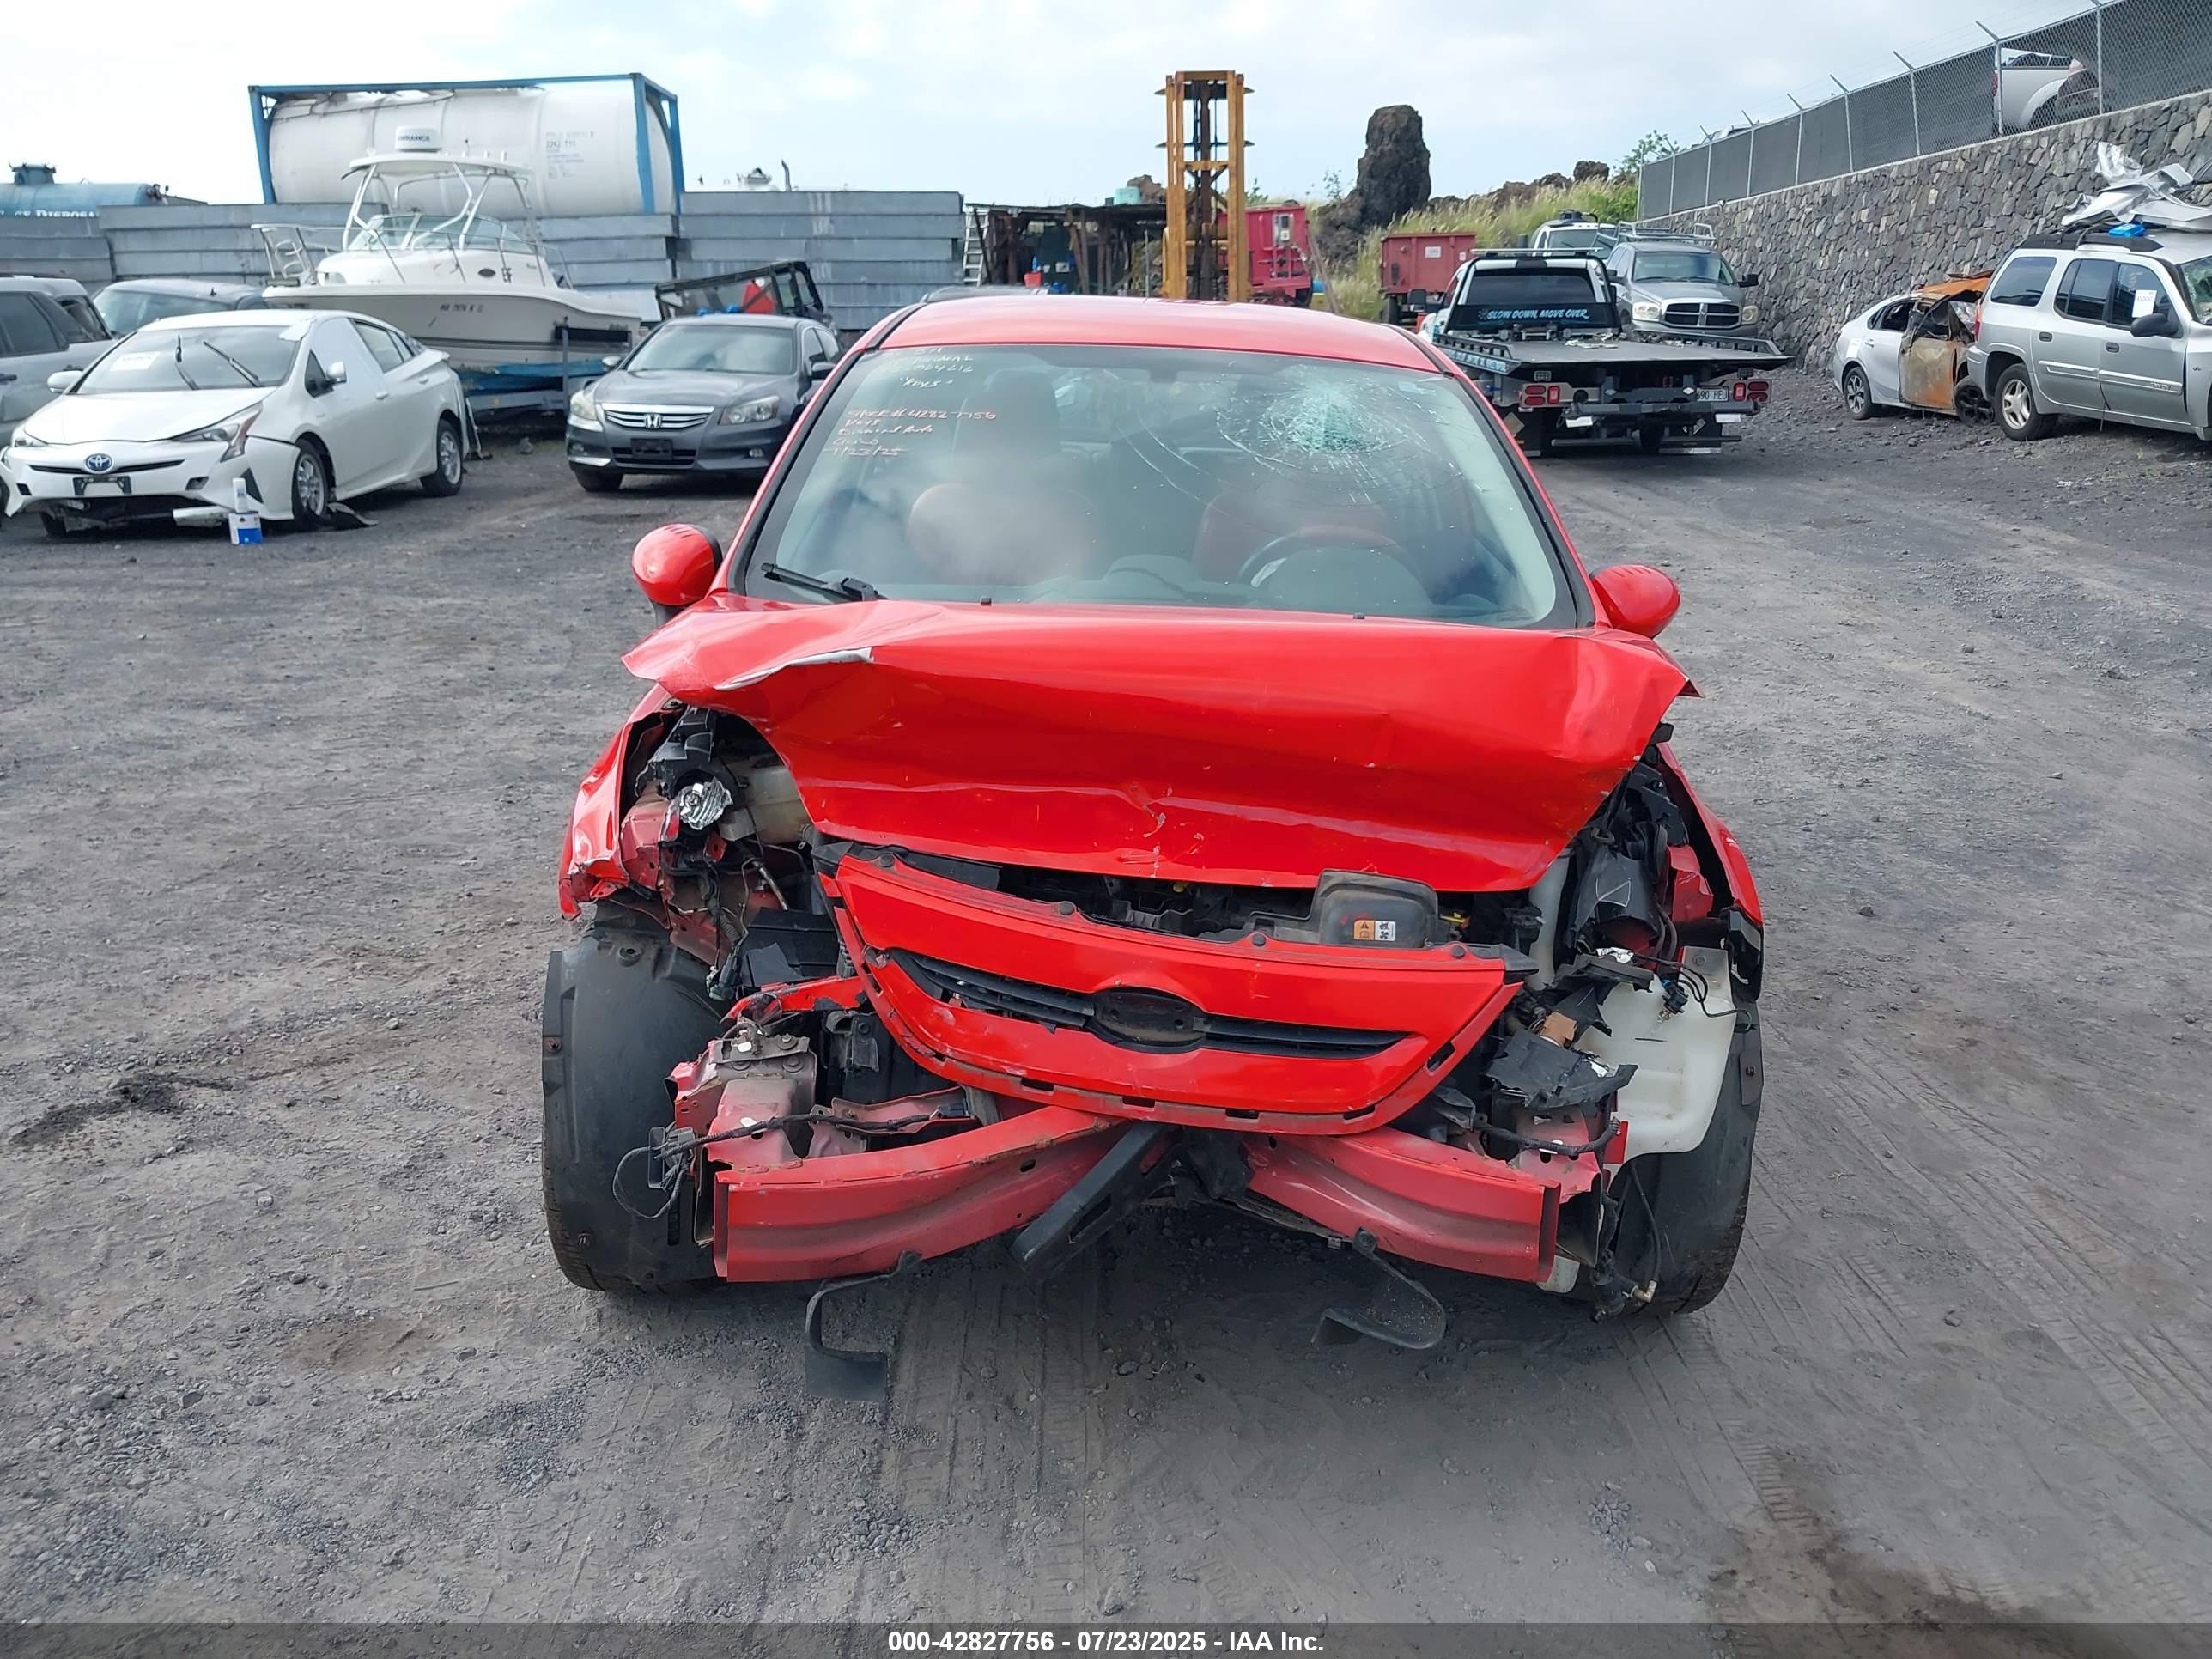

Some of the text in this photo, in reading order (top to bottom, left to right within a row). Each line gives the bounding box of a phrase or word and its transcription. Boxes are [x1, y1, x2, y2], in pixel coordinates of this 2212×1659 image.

[1486, 310, 1512, 319] SLOW
[1539, 309, 1564, 319] MOVE
[1565, 308, 1590, 319] OVER
